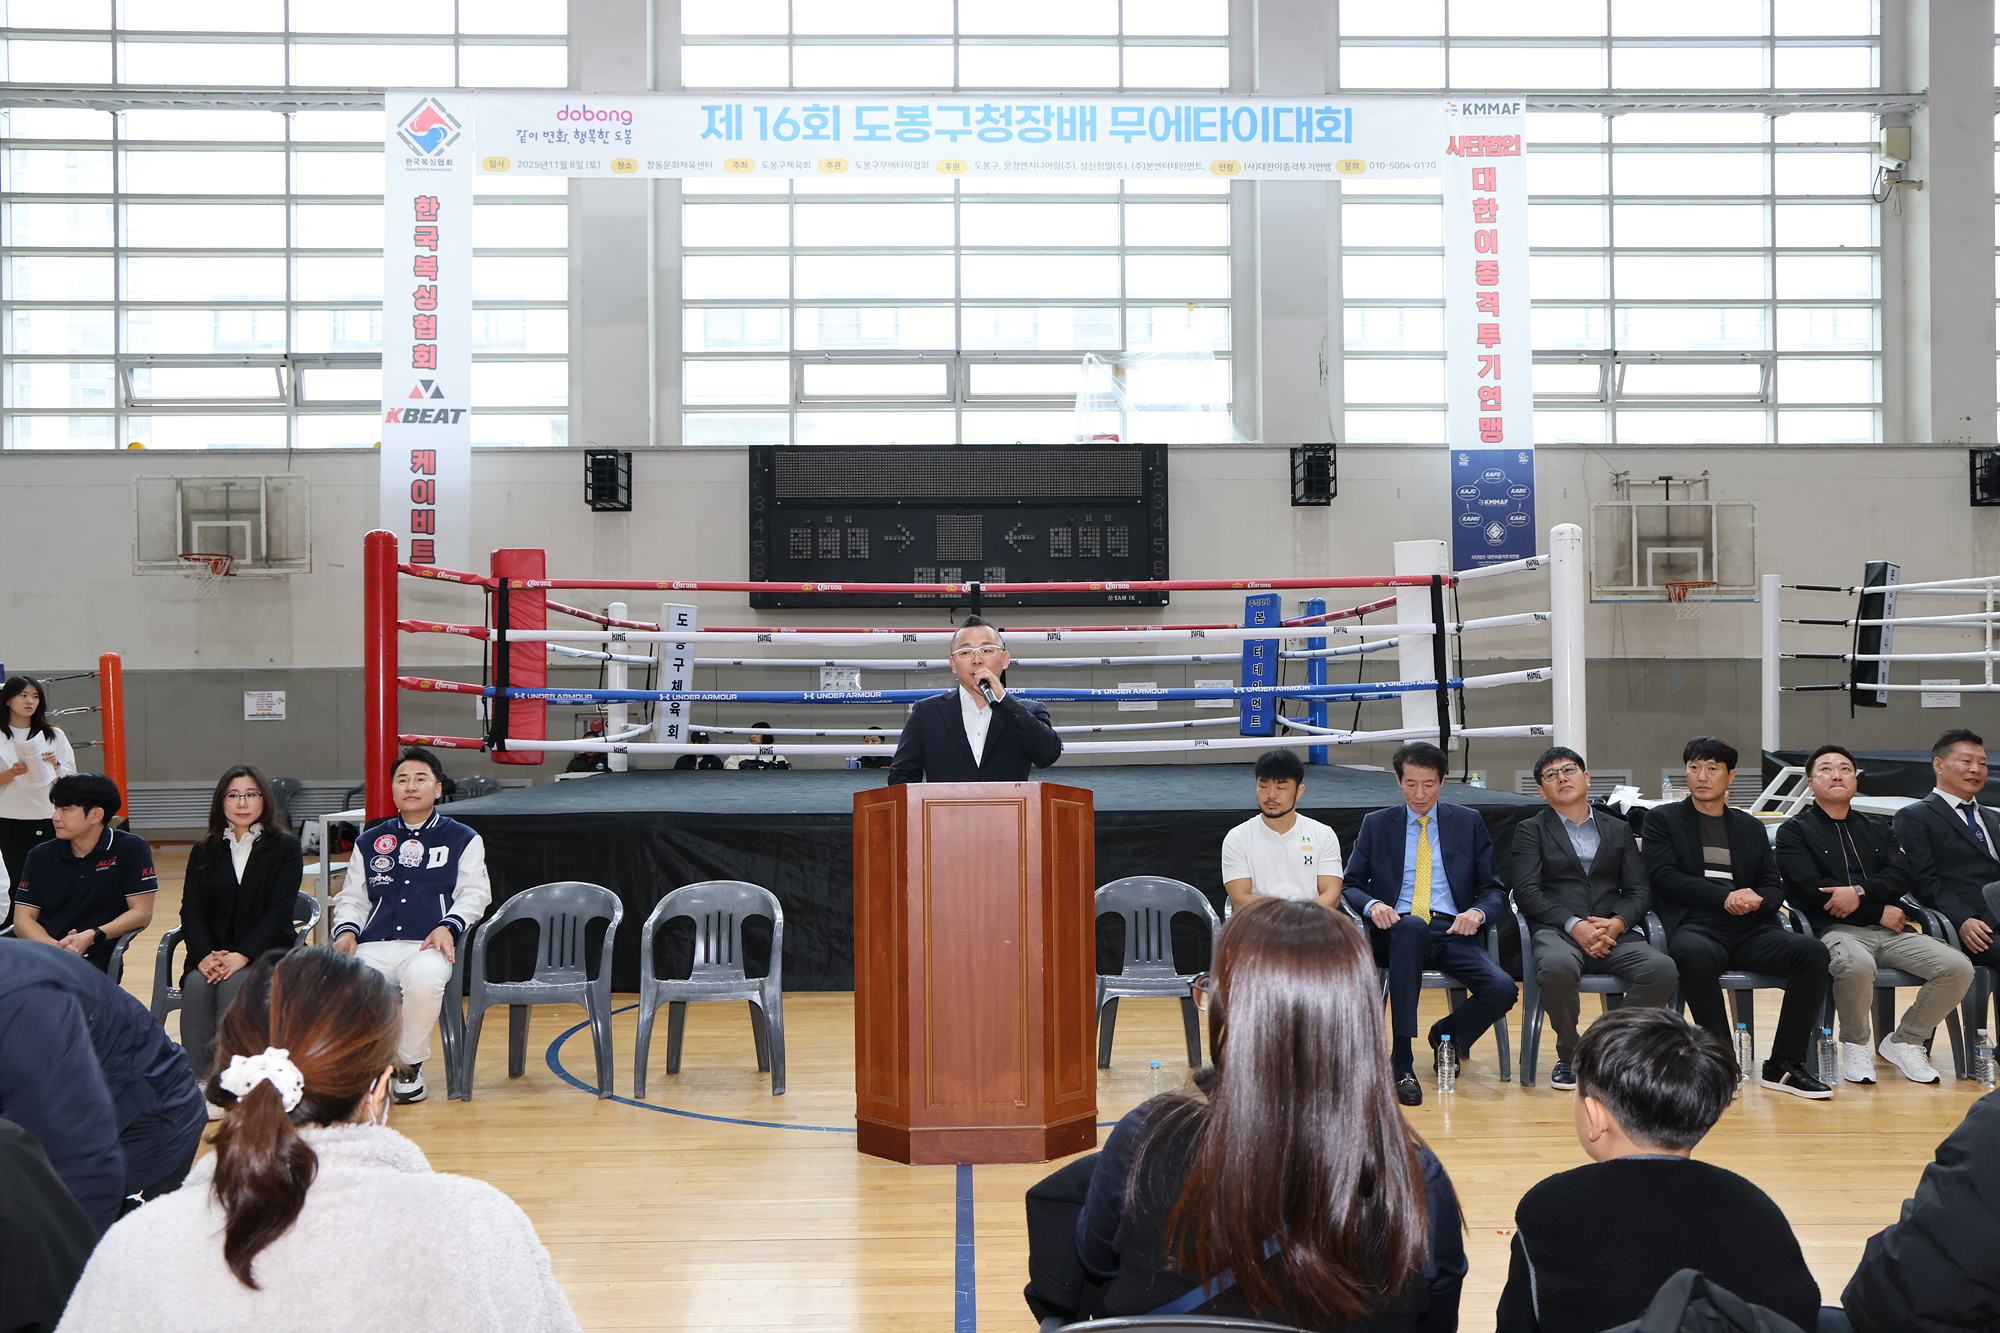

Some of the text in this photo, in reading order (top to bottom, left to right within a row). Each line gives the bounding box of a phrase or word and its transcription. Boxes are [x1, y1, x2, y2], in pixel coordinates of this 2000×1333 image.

[1462, 102, 1520, 115] KMMAF
[556, 104, 632, 126] dobong
[700, 103, 1352, 144] 제 16회 도봉구청장배 무에타이대회
[516, 129, 538, 144] 같이
[573, 128, 610, 144] 행복한
[614, 128, 632, 145] 도봉
[1446, 134, 1521, 158] 사단법인
[405, 158, 453, 166] 한국복싱협회
[488, 159, 505, 168] 일시
[569, 160, 584, 170] 8일
[585, 160, 601, 170] (토)
[616, 161, 632, 170] 장소
[646, 160, 713, 170] 창동문화체육센터
[732, 161, 748, 170] 주최
[761, 160, 812, 170] 도봉구체육회
[826, 161, 842, 170] 주관
[854, 160, 930, 170] 도봉구무에타이협회
[944, 162, 960, 171] 후원
[974, 161, 1002, 172] 도봉구,
[1218, 162, 1234, 172] 인정
[1243, 162, 1332, 172] (사)대한이종격투기연맹
[1344, 162, 1360, 172] 문의
[1368, 162, 1436, 170] 010-5004-0170
[412, 195, 440, 370] 한국복싱협회
[1472, 166, 1504, 444] 대한이종격투기연맹
[384, 407, 467, 424] KBEAT
[1154, 450, 1162, 466] 1
[1152, 472, 1164, 488] 2
[410, 449, 436, 564] 케이비트
[1153, 494, 1164, 510] 3
[1153, 516, 1164, 531] 4
[1154, 538, 1164, 554] 5
[1154, 560, 1164, 576] 6
[437, 571, 461, 582] Corona
[526, 580, 552, 588] Corona
[672, 581, 698, 590] Corona
[818, 582, 842, 591] Corona
[962, 583, 986, 592] Cona
[1105, 582, 1130, 590] Corona
[446, 625, 470, 634] Corona
[612, 632, 626, 642] KING
[757, 633, 772, 644] KING
[902, 633, 918, 644] KING
[1250, 610, 1266, 728] 본터테인먼트
[434, 681, 458, 690] Corona
[816, 692, 844, 700] UNDER
[432, 738, 456, 748] Corona
[759, 746, 774, 755] KING
[426, 846, 450, 870] D
